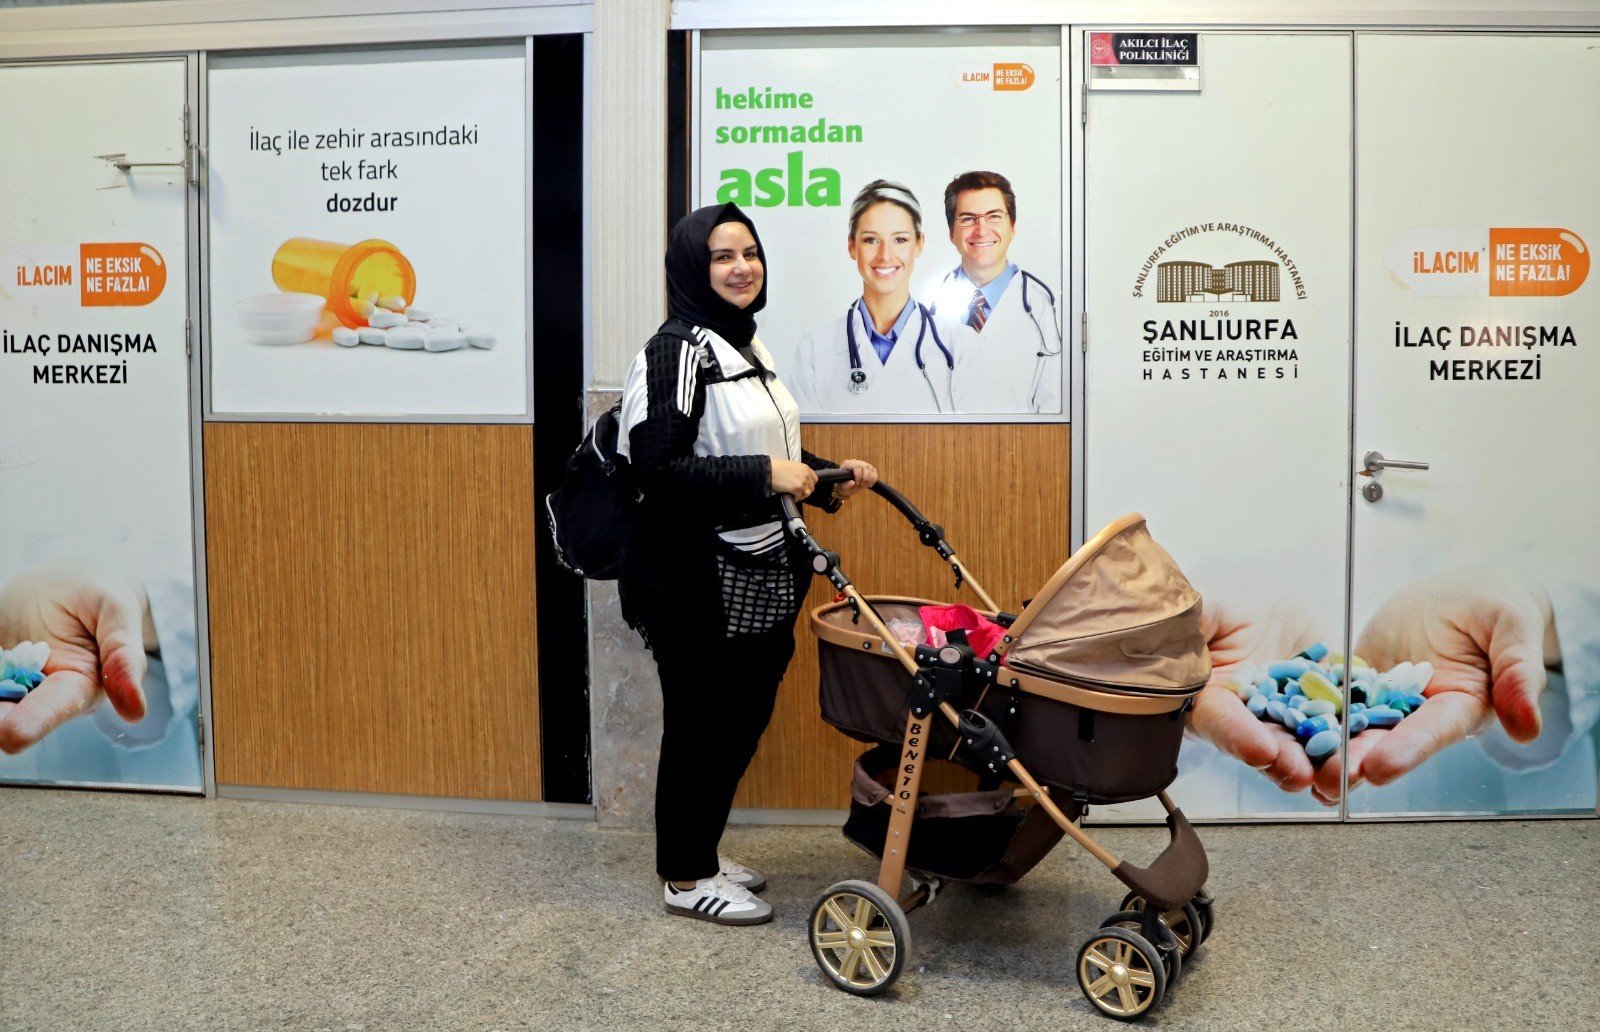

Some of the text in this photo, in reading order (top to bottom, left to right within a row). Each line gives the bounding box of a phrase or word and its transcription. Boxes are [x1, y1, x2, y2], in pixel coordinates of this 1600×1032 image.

[1120, 37, 1189, 50] AKILCI İLAÇ
[1120, 49, 1190, 61] POLİKLİNİĞİ
[996, 69, 1005, 77] NE
[996, 77, 1005, 85] NE
[715, 86, 814, 110] hekime
[250, 124, 478, 156] İlaç ile zehir arasındaki
[715, 117, 863, 144] sormadan
[321, 159, 398, 181] tek fark
[716, 151, 842, 207] asla
[326, 192, 398, 212] dozdur
[1132, 222, 1309, 301] ŞANLIURFA EĞİTİM VE ARAŞTIRMA HASTANESİ
[1496, 244, 1515, 260] NE
[86, 257, 103, 274] NE
[1496, 265, 1571, 281] NE FAZLA!
[86, 275, 150, 293] NE FAZLA!
[1142, 319, 1299, 344] ŞANLIURFA
[1395, 321, 1578, 350] İLAÇ DANIŞMA
[3, 330, 157, 356] İLAÇ DANIŞMA
[1143, 347, 1299, 363] EĞİTİM VE ARAŞTIRMA
[33, 360, 128, 384] MERKEZİ
[1143, 364, 1299, 380] HASTANESİ
[1430, 353, 1542, 381] MERKEZİ
